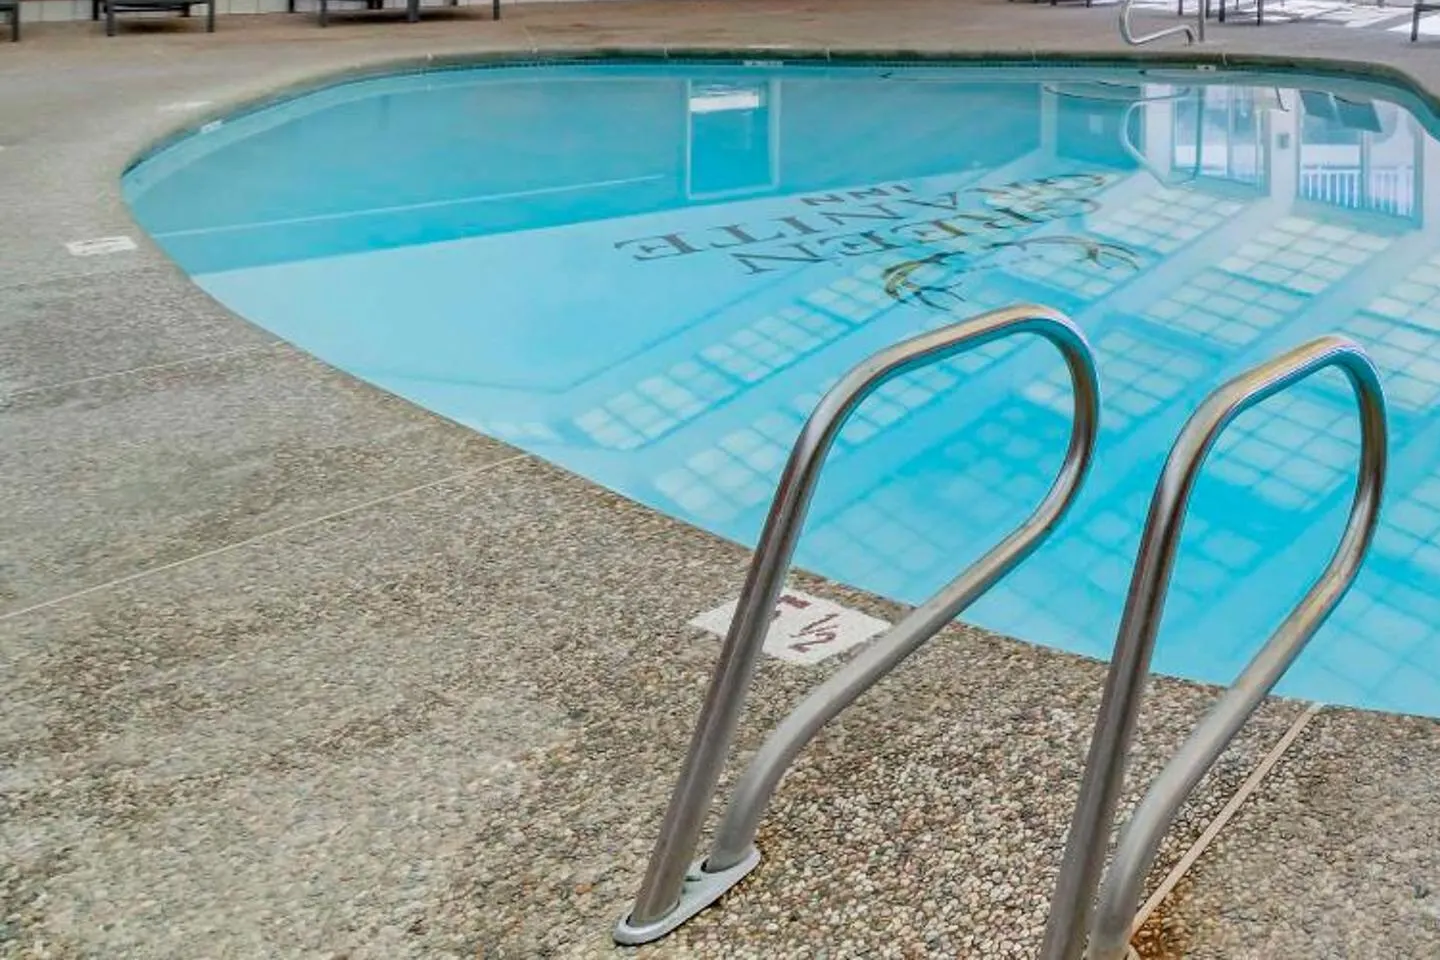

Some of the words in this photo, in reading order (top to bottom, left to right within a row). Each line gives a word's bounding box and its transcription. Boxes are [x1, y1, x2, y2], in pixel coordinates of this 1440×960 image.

[615, 174, 1105, 261] GRANITE
[803, 183, 912, 206] INN
[731, 197, 1099, 274] GREEN
